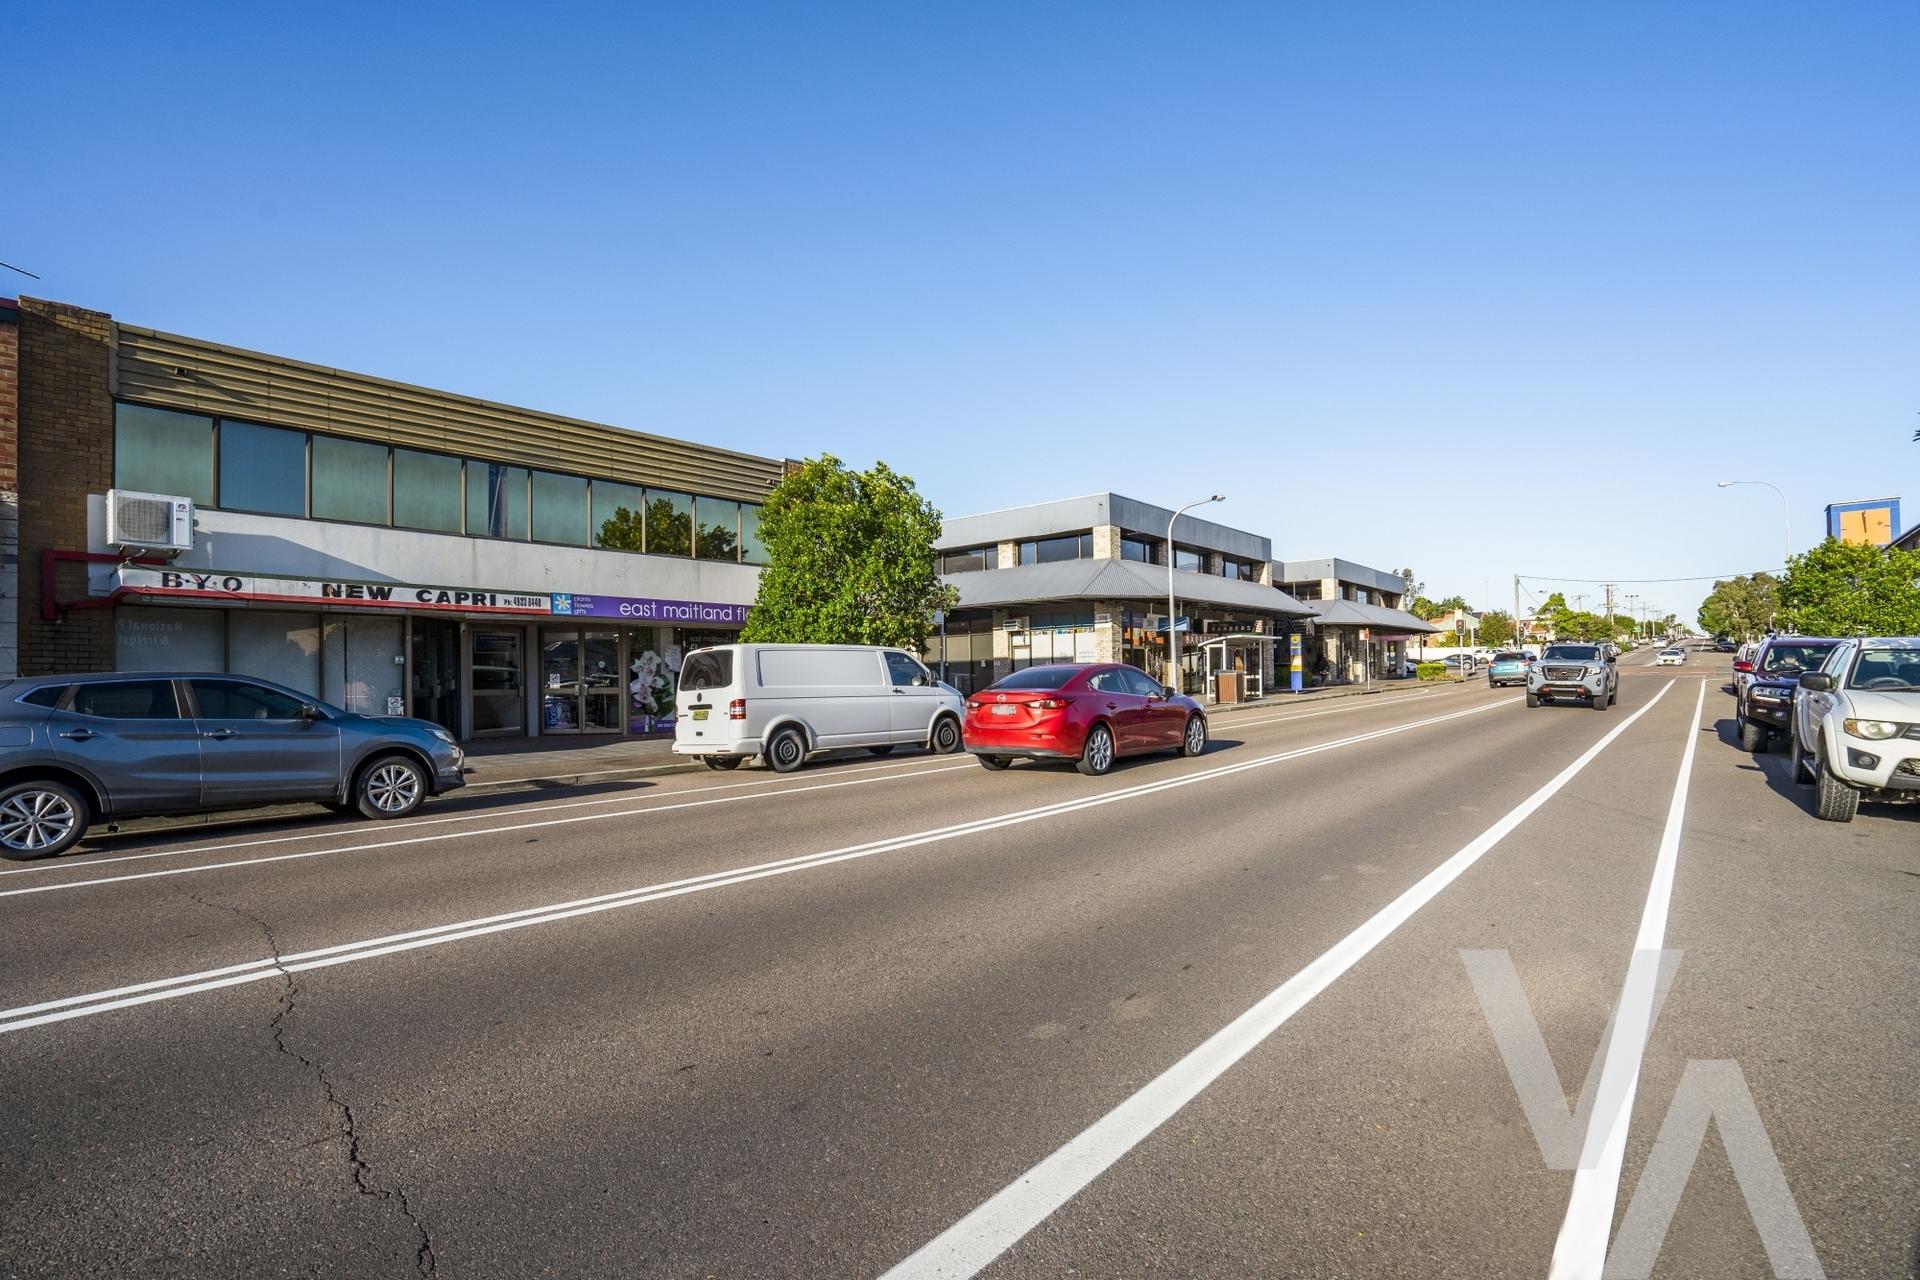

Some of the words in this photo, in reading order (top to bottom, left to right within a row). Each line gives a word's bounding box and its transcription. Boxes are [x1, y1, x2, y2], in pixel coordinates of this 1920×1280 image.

[321, 583, 393, 601] NEW
[415, 589, 496, 606] CAPRI
[620, 601, 657, 617] east
[663, 603, 732, 620] maitland
